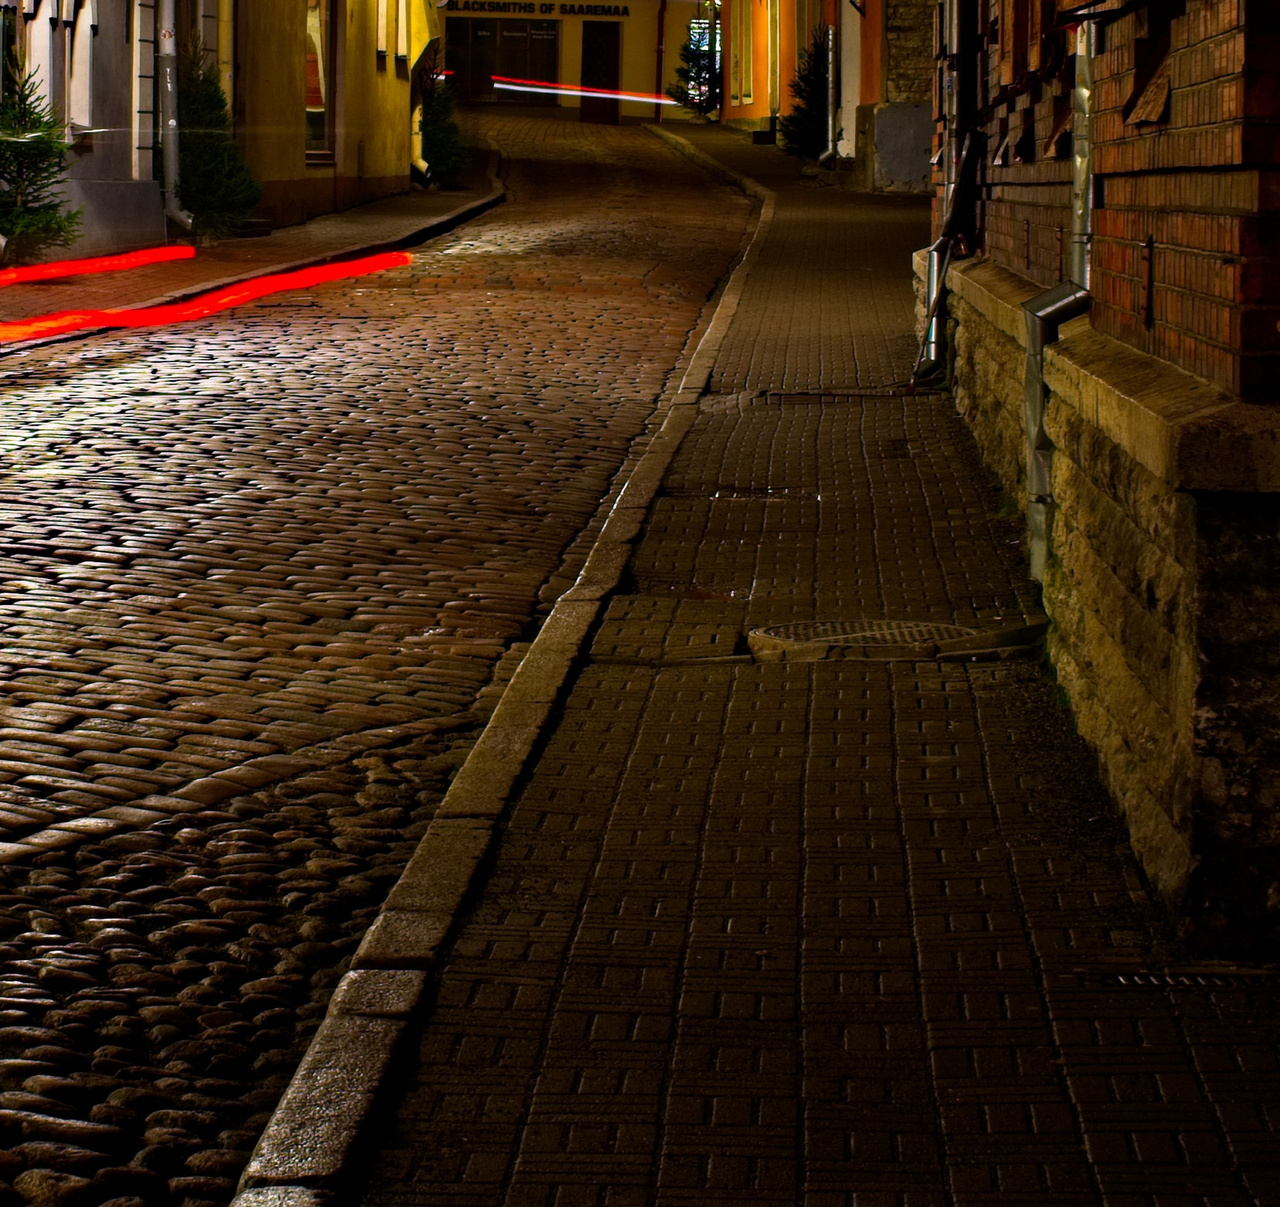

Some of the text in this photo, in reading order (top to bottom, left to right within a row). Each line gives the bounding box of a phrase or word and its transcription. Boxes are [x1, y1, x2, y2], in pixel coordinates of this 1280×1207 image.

[447, 0, 630, 17] BLACKSMITHS OF SAAREMAA
